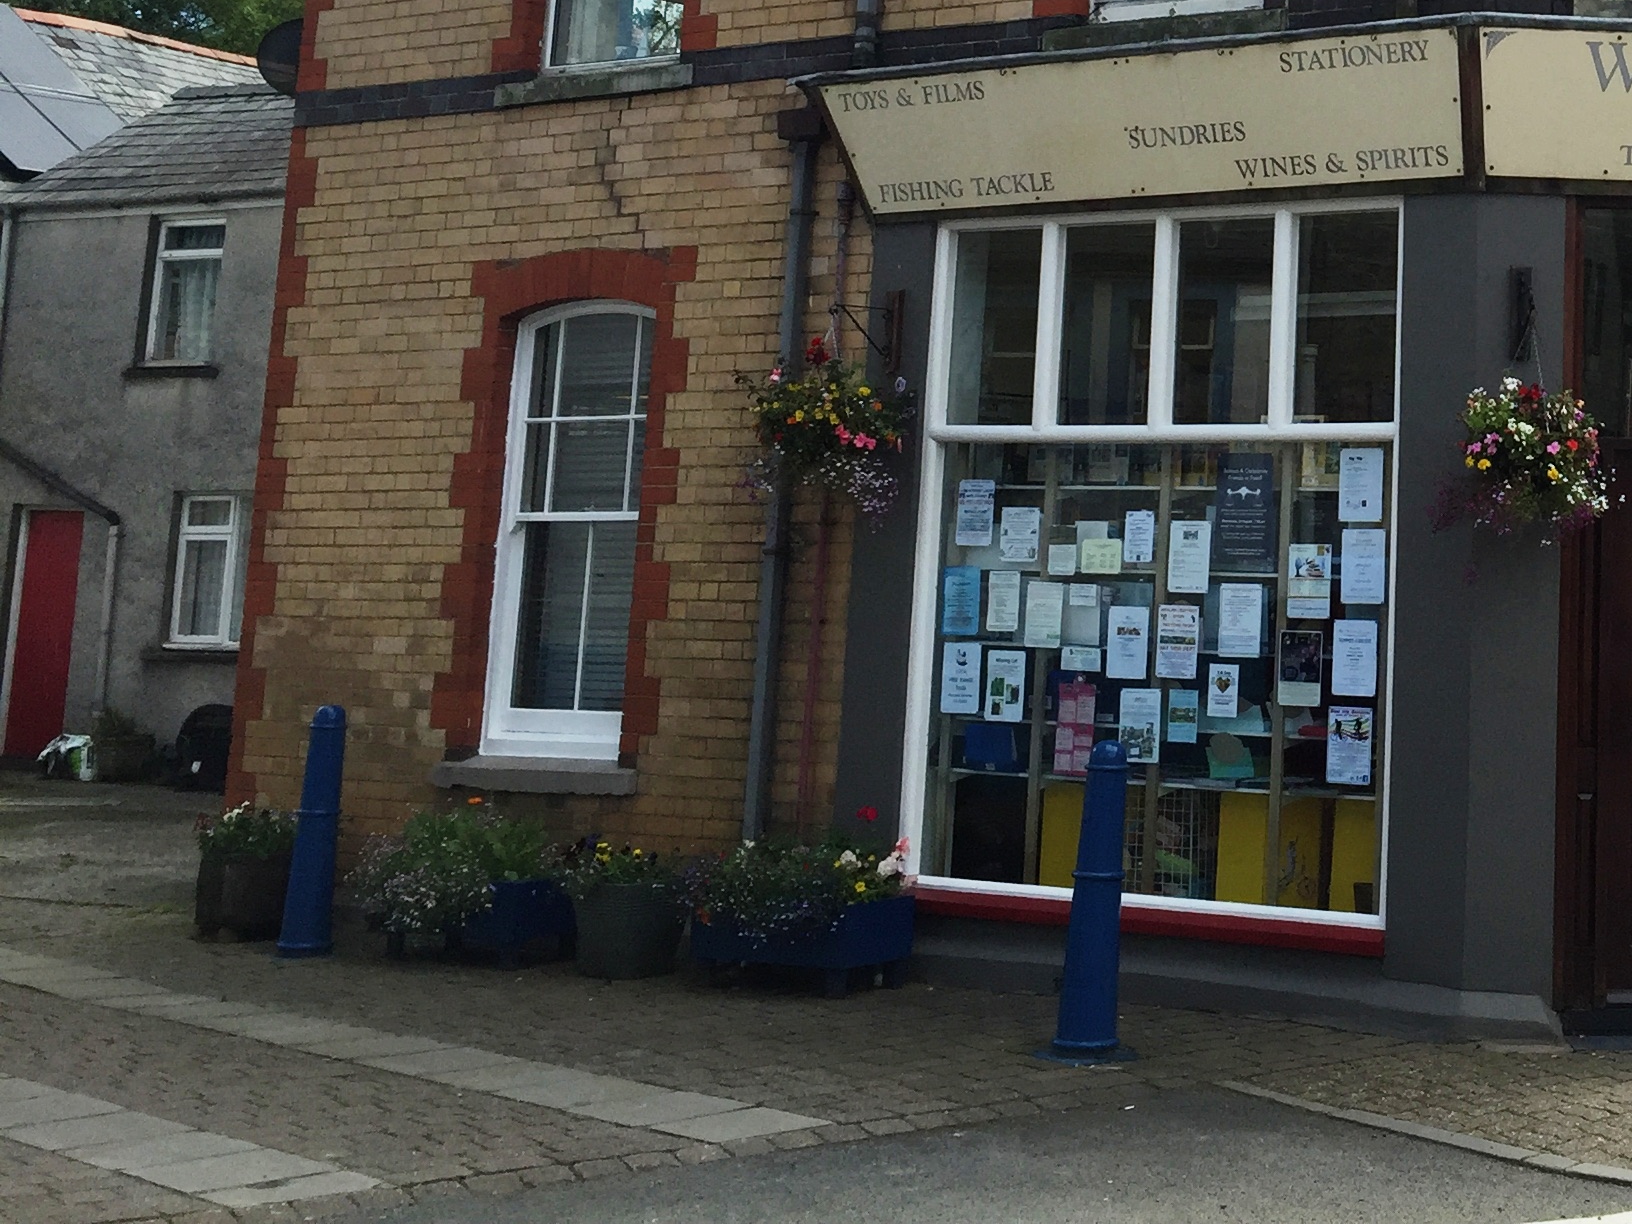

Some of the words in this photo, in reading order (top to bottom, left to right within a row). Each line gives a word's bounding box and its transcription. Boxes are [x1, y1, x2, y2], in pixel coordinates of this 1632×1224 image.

[1279, 38, 1430, 74] STATIONERY
[838, 89, 890, 113] TOYS
[896, 87, 915, 107] &
[922, 81, 985, 106] FILMS
[1128, 120, 1247, 150] SUNDRIES
[1234, 154, 1318, 179] WINES
[1325, 152, 1346, 175] &
[1356, 145, 1450, 173] SPIRITS
[878, 179, 964, 204] FISHING
[971, 173, 1055, 196] TACKLE
